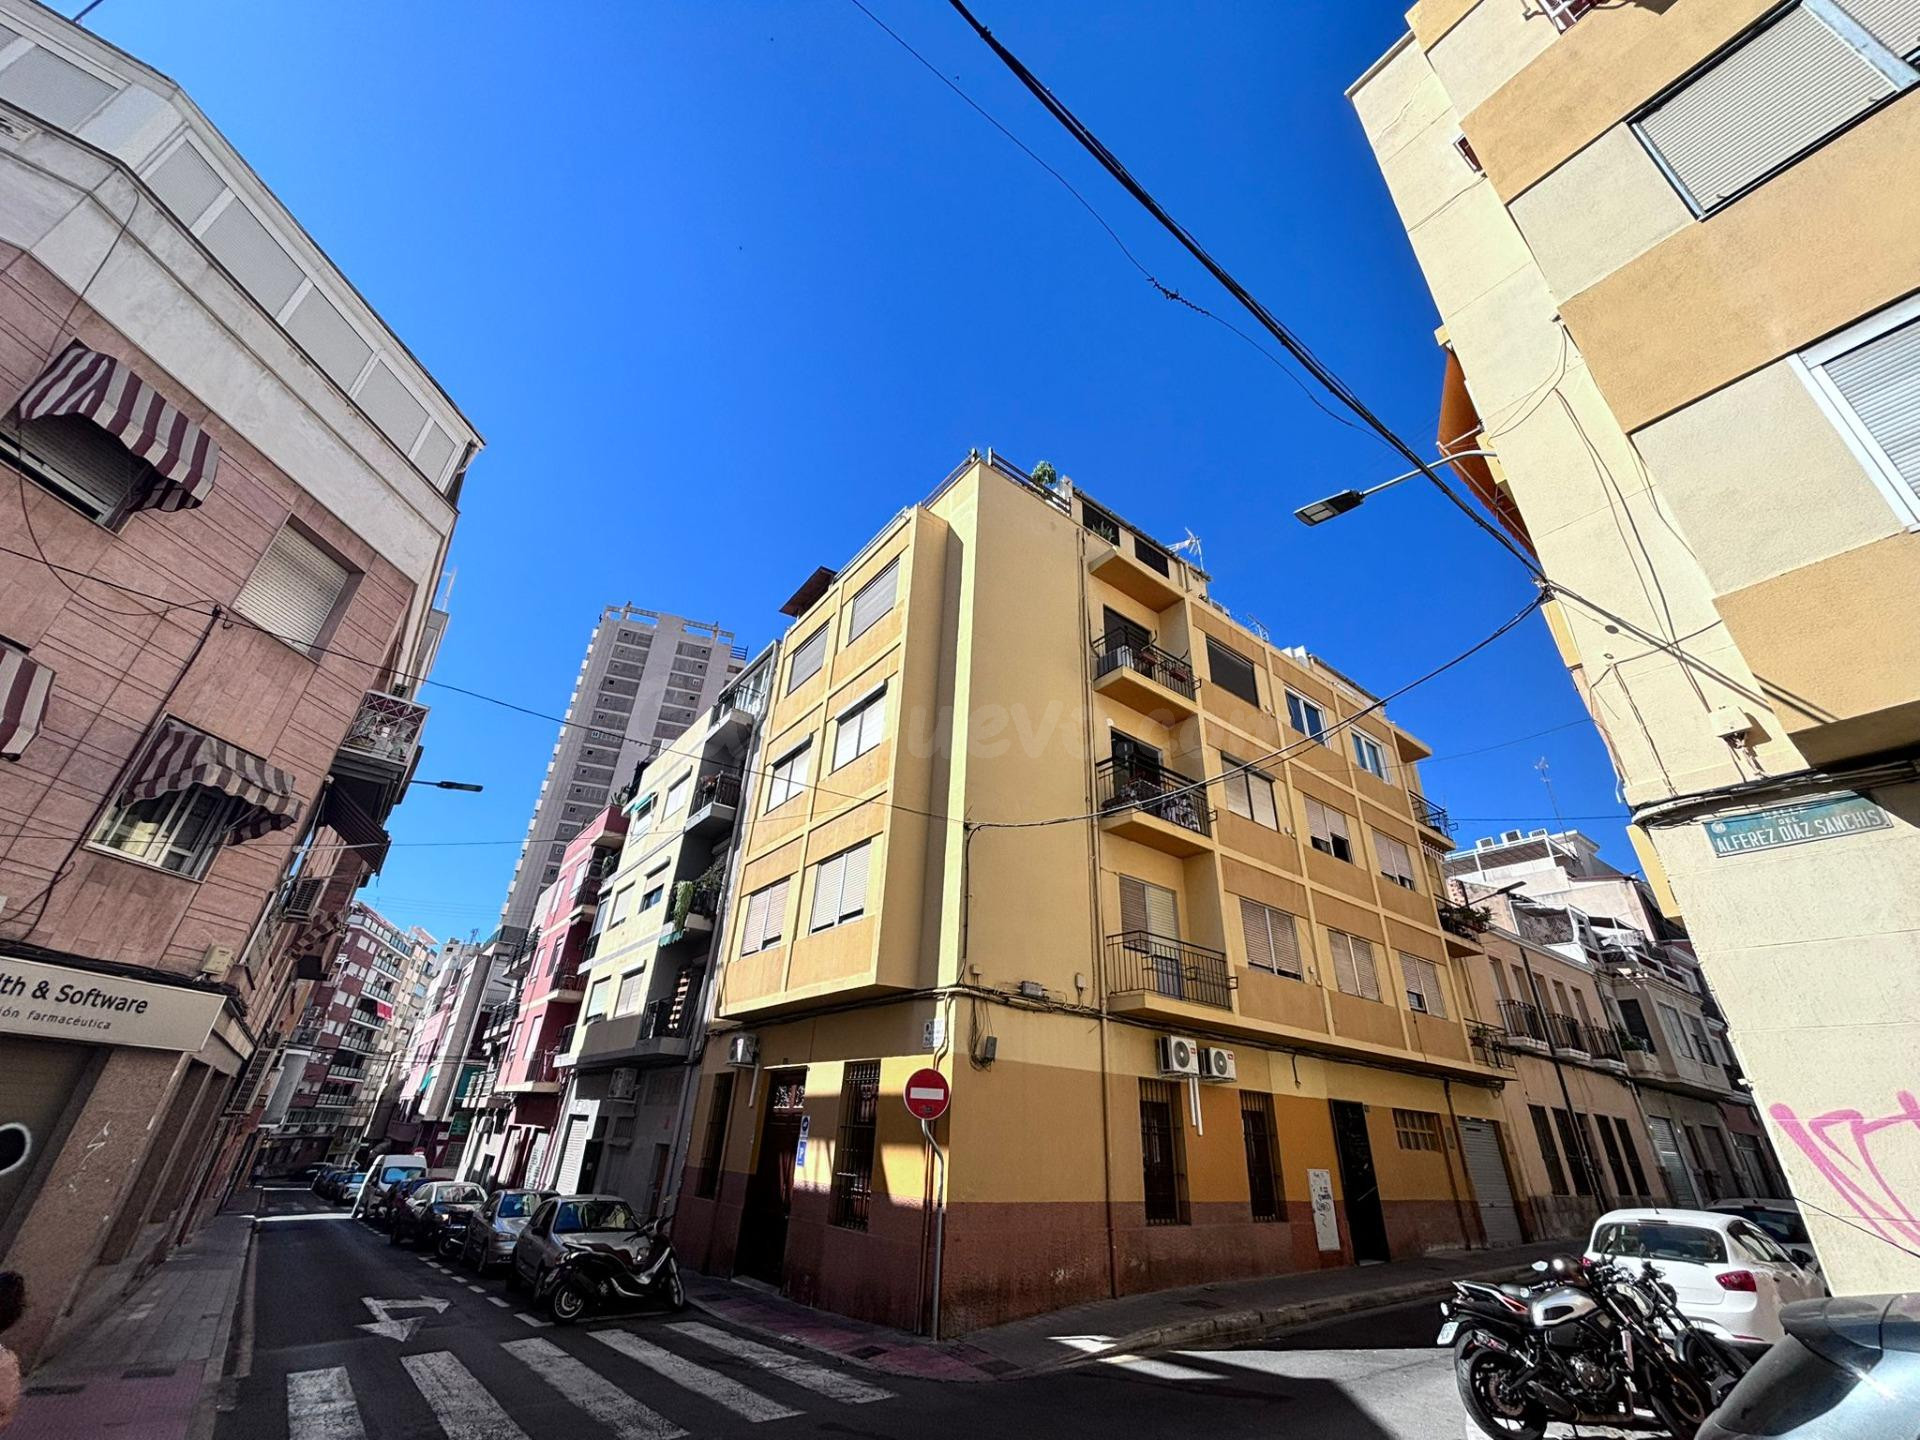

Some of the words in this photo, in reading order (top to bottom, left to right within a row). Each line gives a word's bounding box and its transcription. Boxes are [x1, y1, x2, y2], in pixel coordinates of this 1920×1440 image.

[1814, 809, 1879, 834] SANCHIS
[31, 980, 50, 1000] &
[54, 984, 148, 1014] Software
[0, 1006, 20, 1018] ón
[27, 1010, 112, 1030] farmacéutica
